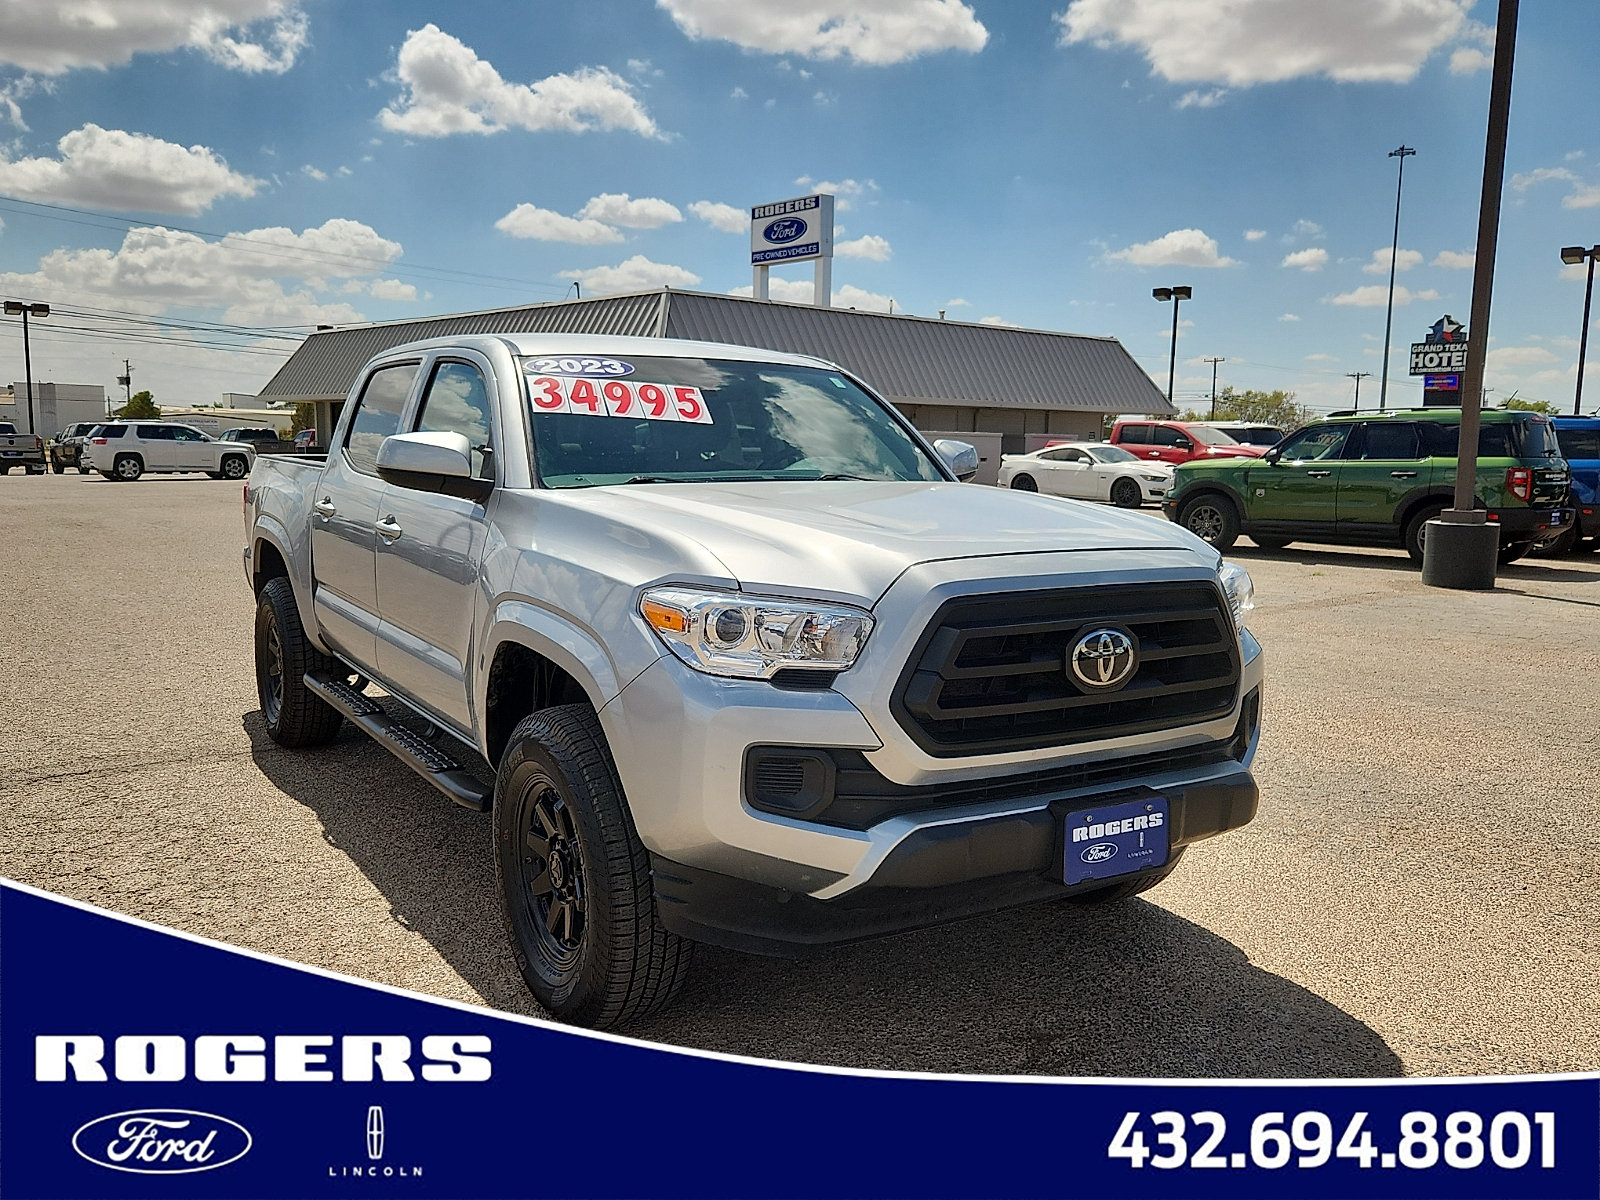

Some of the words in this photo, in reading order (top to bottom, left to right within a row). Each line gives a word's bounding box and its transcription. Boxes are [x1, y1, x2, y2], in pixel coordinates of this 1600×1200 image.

[754, 198, 815, 218] ROGERS
[771, 221, 797, 239] Ford
[753, 250, 787, 261] PRE-OWNED
[788, 245, 817, 255] VEHICLES
[1412, 344, 1443, 353] GRAND
[1444, 343, 1468, 351] TEXA
[536, 359, 624, 374] 2023
[533, 377, 702, 420] 34995
[1073, 813, 1163, 842] ROGERS
[1088, 846, 1111, 860] Ford
